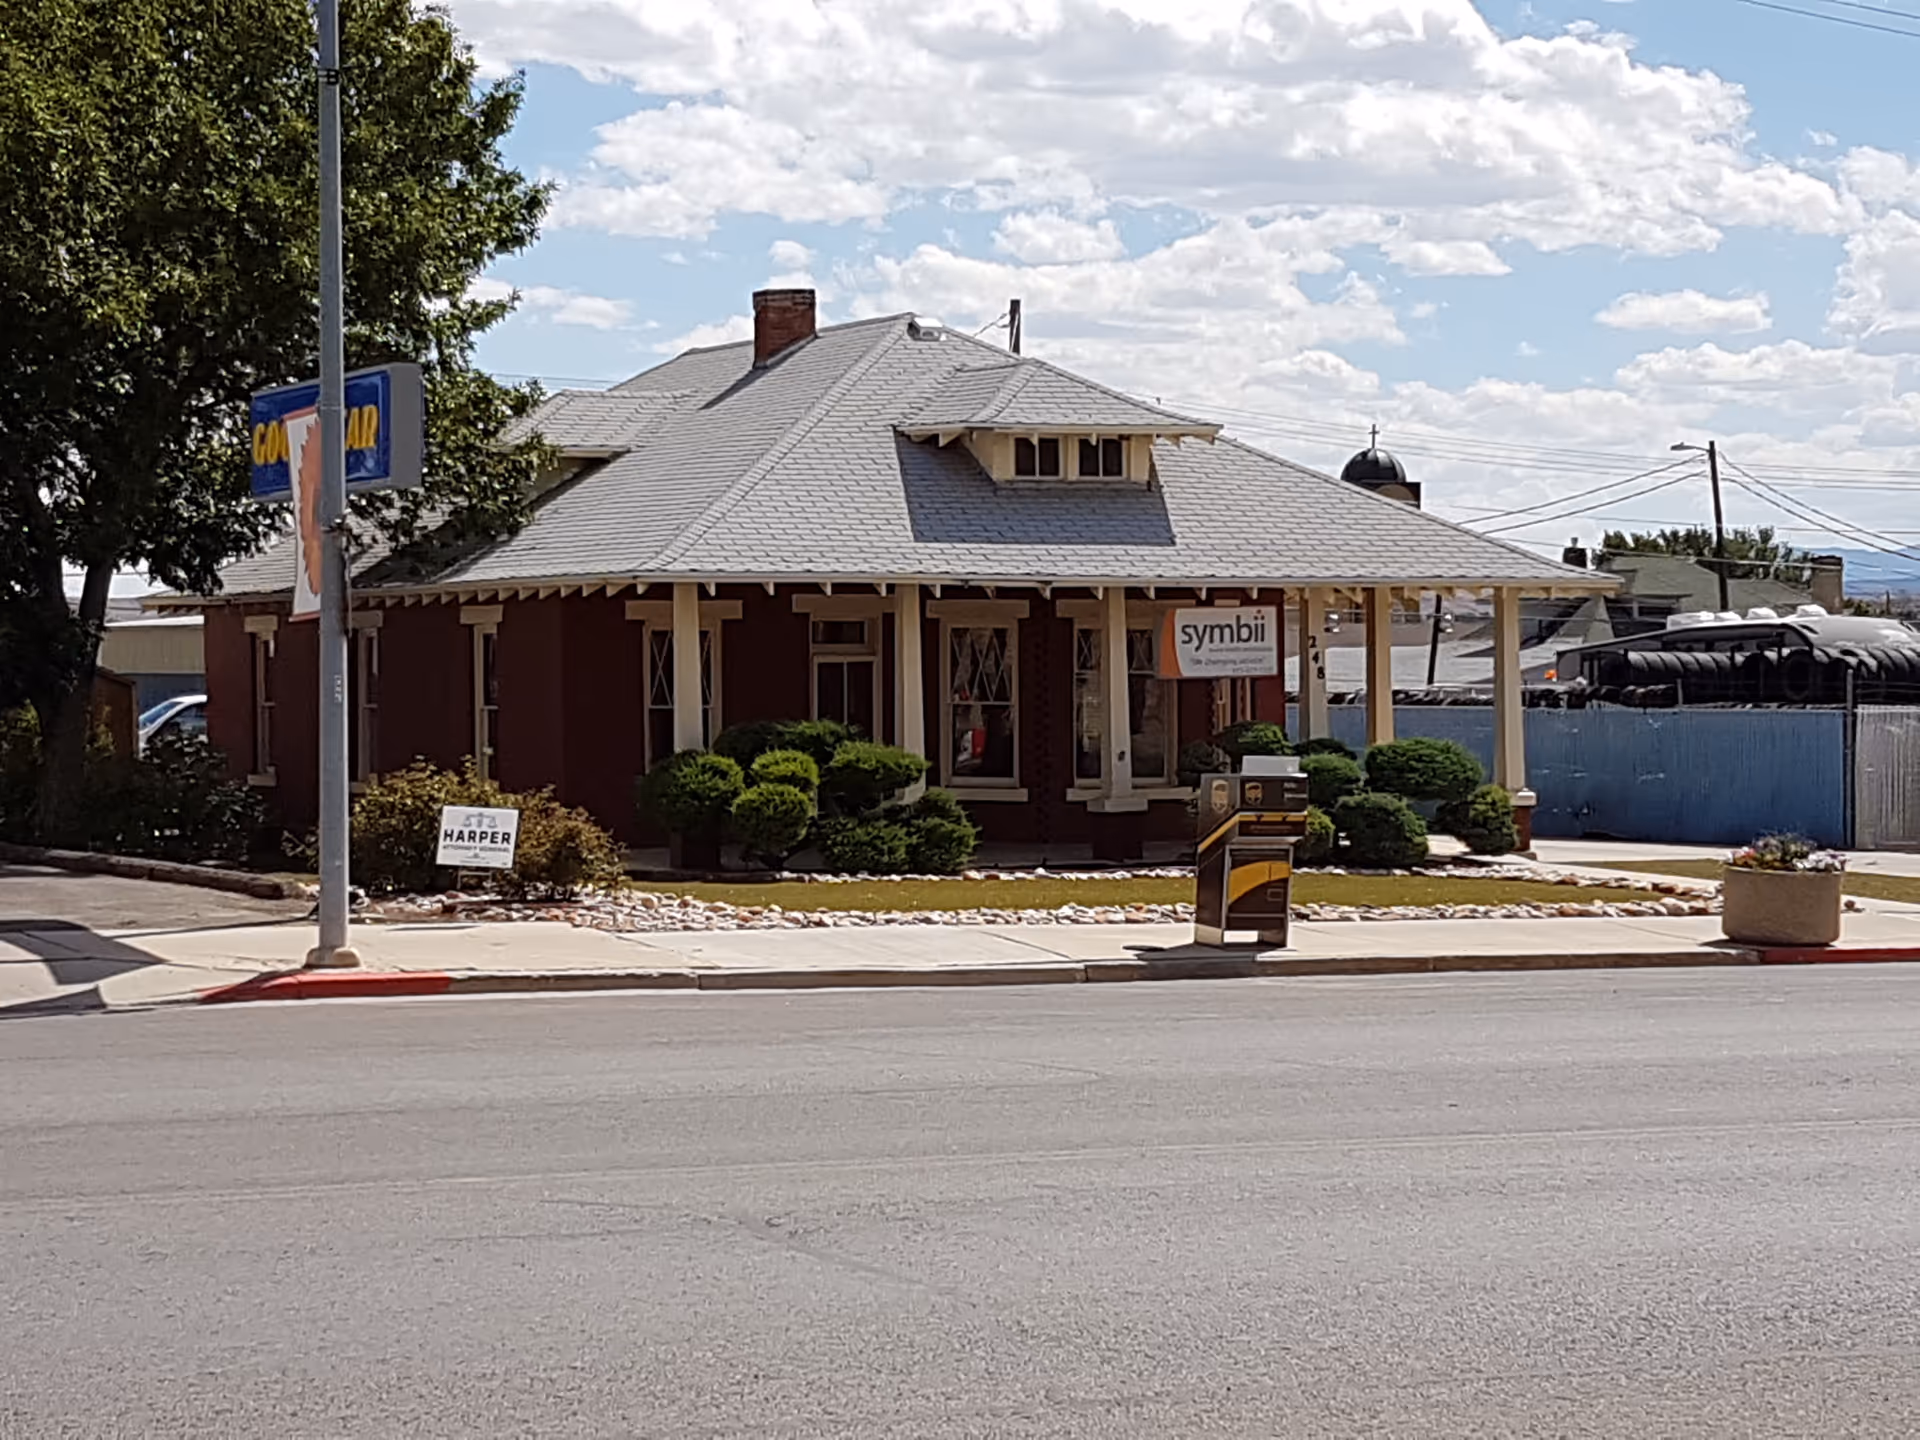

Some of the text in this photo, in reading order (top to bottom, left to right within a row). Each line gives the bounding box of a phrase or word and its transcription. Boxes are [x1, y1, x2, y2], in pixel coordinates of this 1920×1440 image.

[1181, 613, 1265, 652] symbii
[1308, 635, 1326, 680] 248
[443, 829, 511, 845] HARPER
